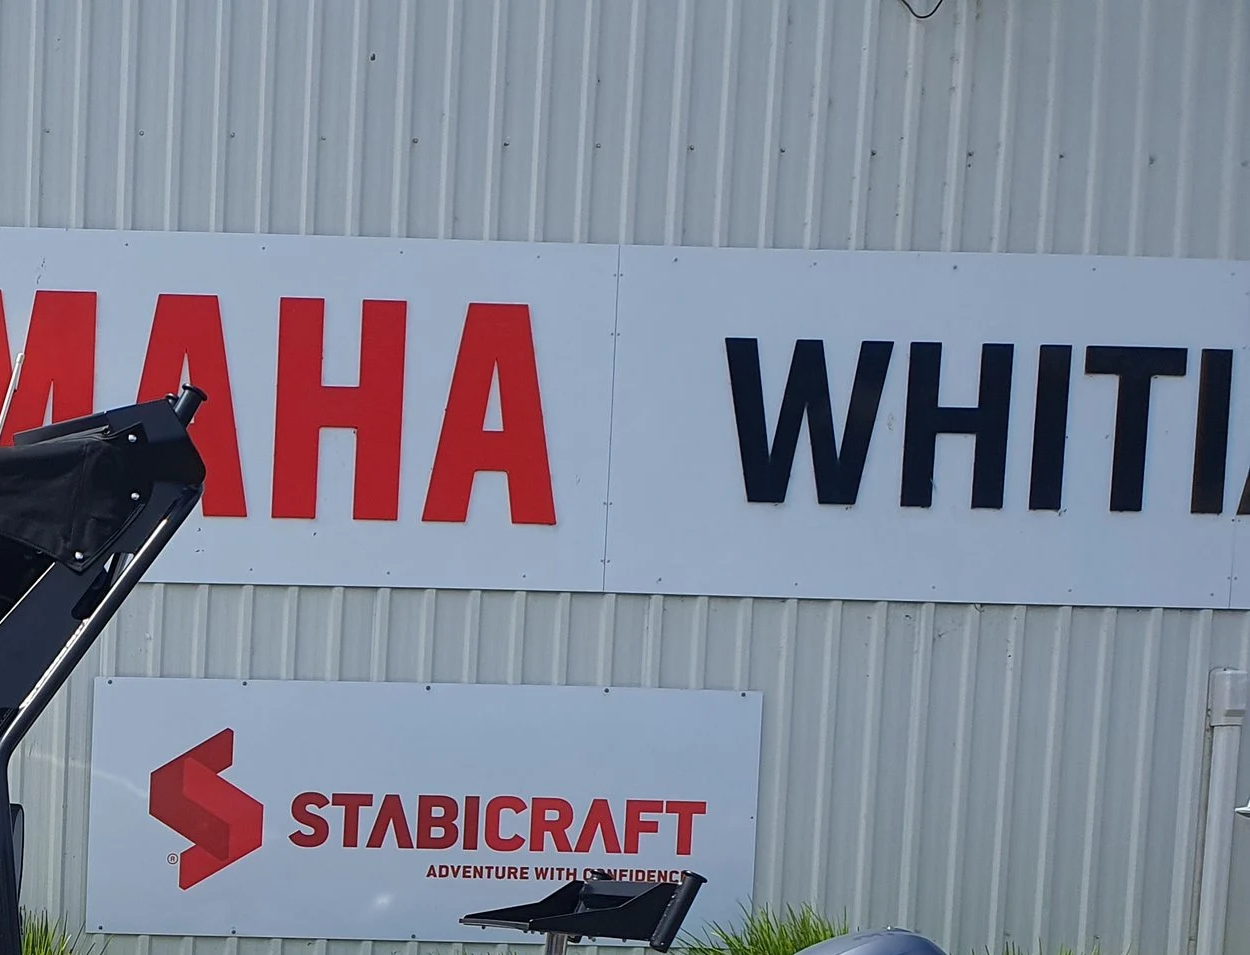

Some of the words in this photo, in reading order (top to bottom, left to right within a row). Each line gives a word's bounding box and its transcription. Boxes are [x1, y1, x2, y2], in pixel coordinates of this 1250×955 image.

[725, 337, 1250, 516] WHITI
[288, 791, 708, 856] STABICRAFT
[425, 864, 530, 880] ADVENTURE
[535, 867, 577, 882] WITH
